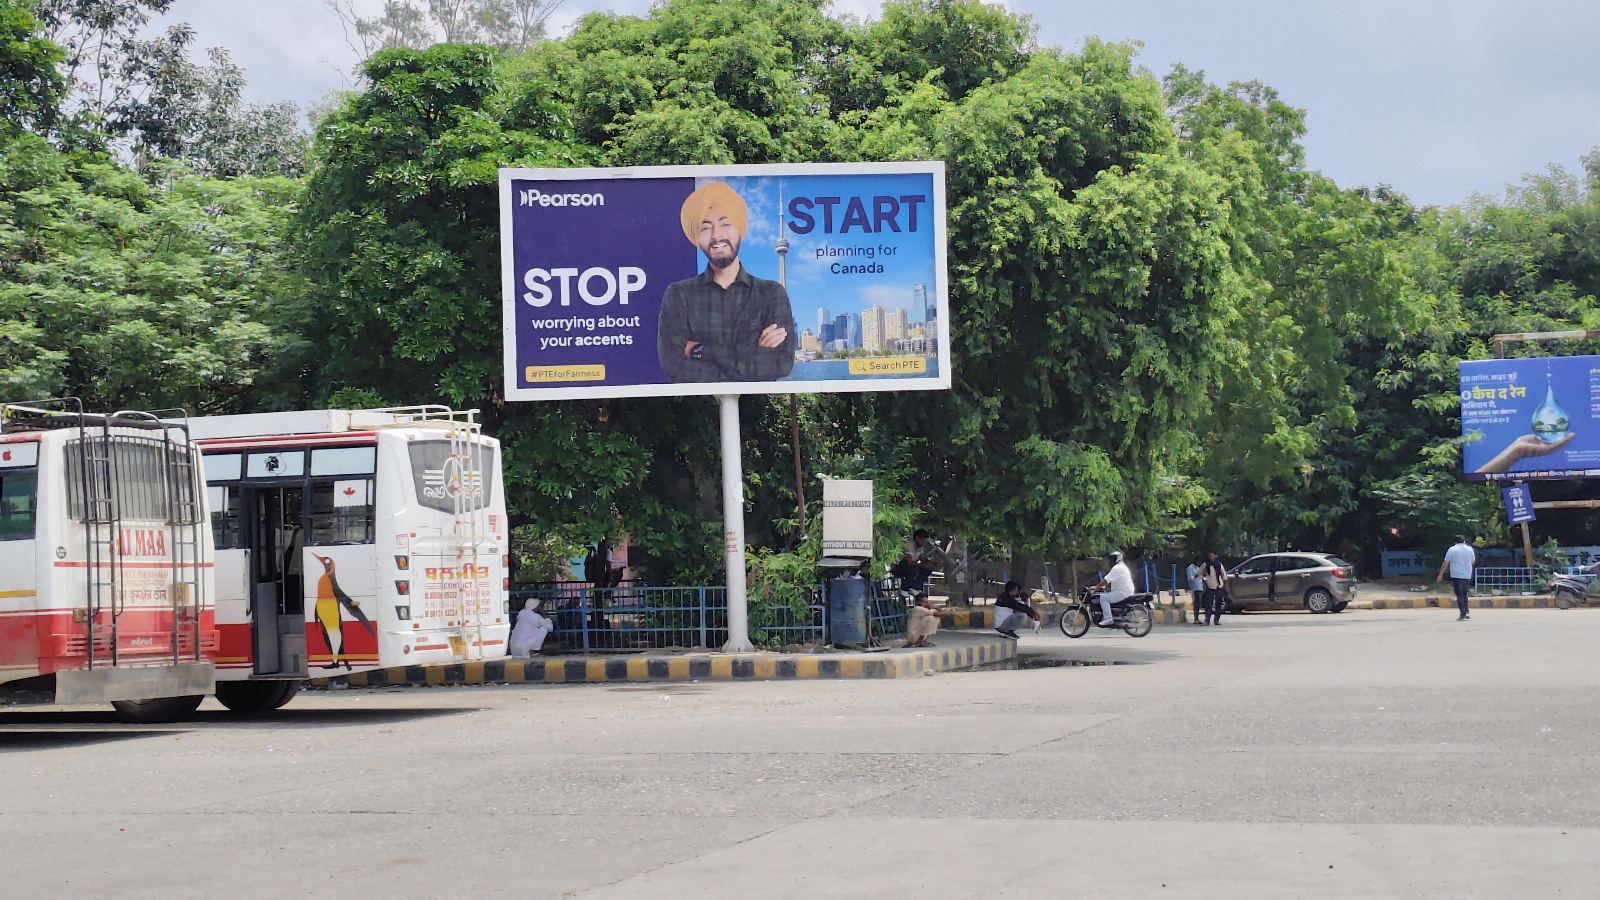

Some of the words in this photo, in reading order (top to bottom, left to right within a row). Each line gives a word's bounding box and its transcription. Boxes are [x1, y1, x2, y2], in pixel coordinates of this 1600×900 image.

[528, 189, 604, 207] Pearson
[788, 195, 926, 235] START
[816, 245, 875, 259] planning
[878, 244, 898, 256] for
[830, 262, 884, 275] Canada
[523, 266, 647, 308] STOP
[532, 315, 595, 331] worrying
[597, 315, 641, 328] about
[540, 334, 573, 350] your
[575, 333, 633, 346] accents
[902, 360, 920, 369] PTE
[531, 368, 601, 379] #PTEforFairness
[1471, 386, 1496, 399] कैच
[135, 528, 167, 556] MAA
